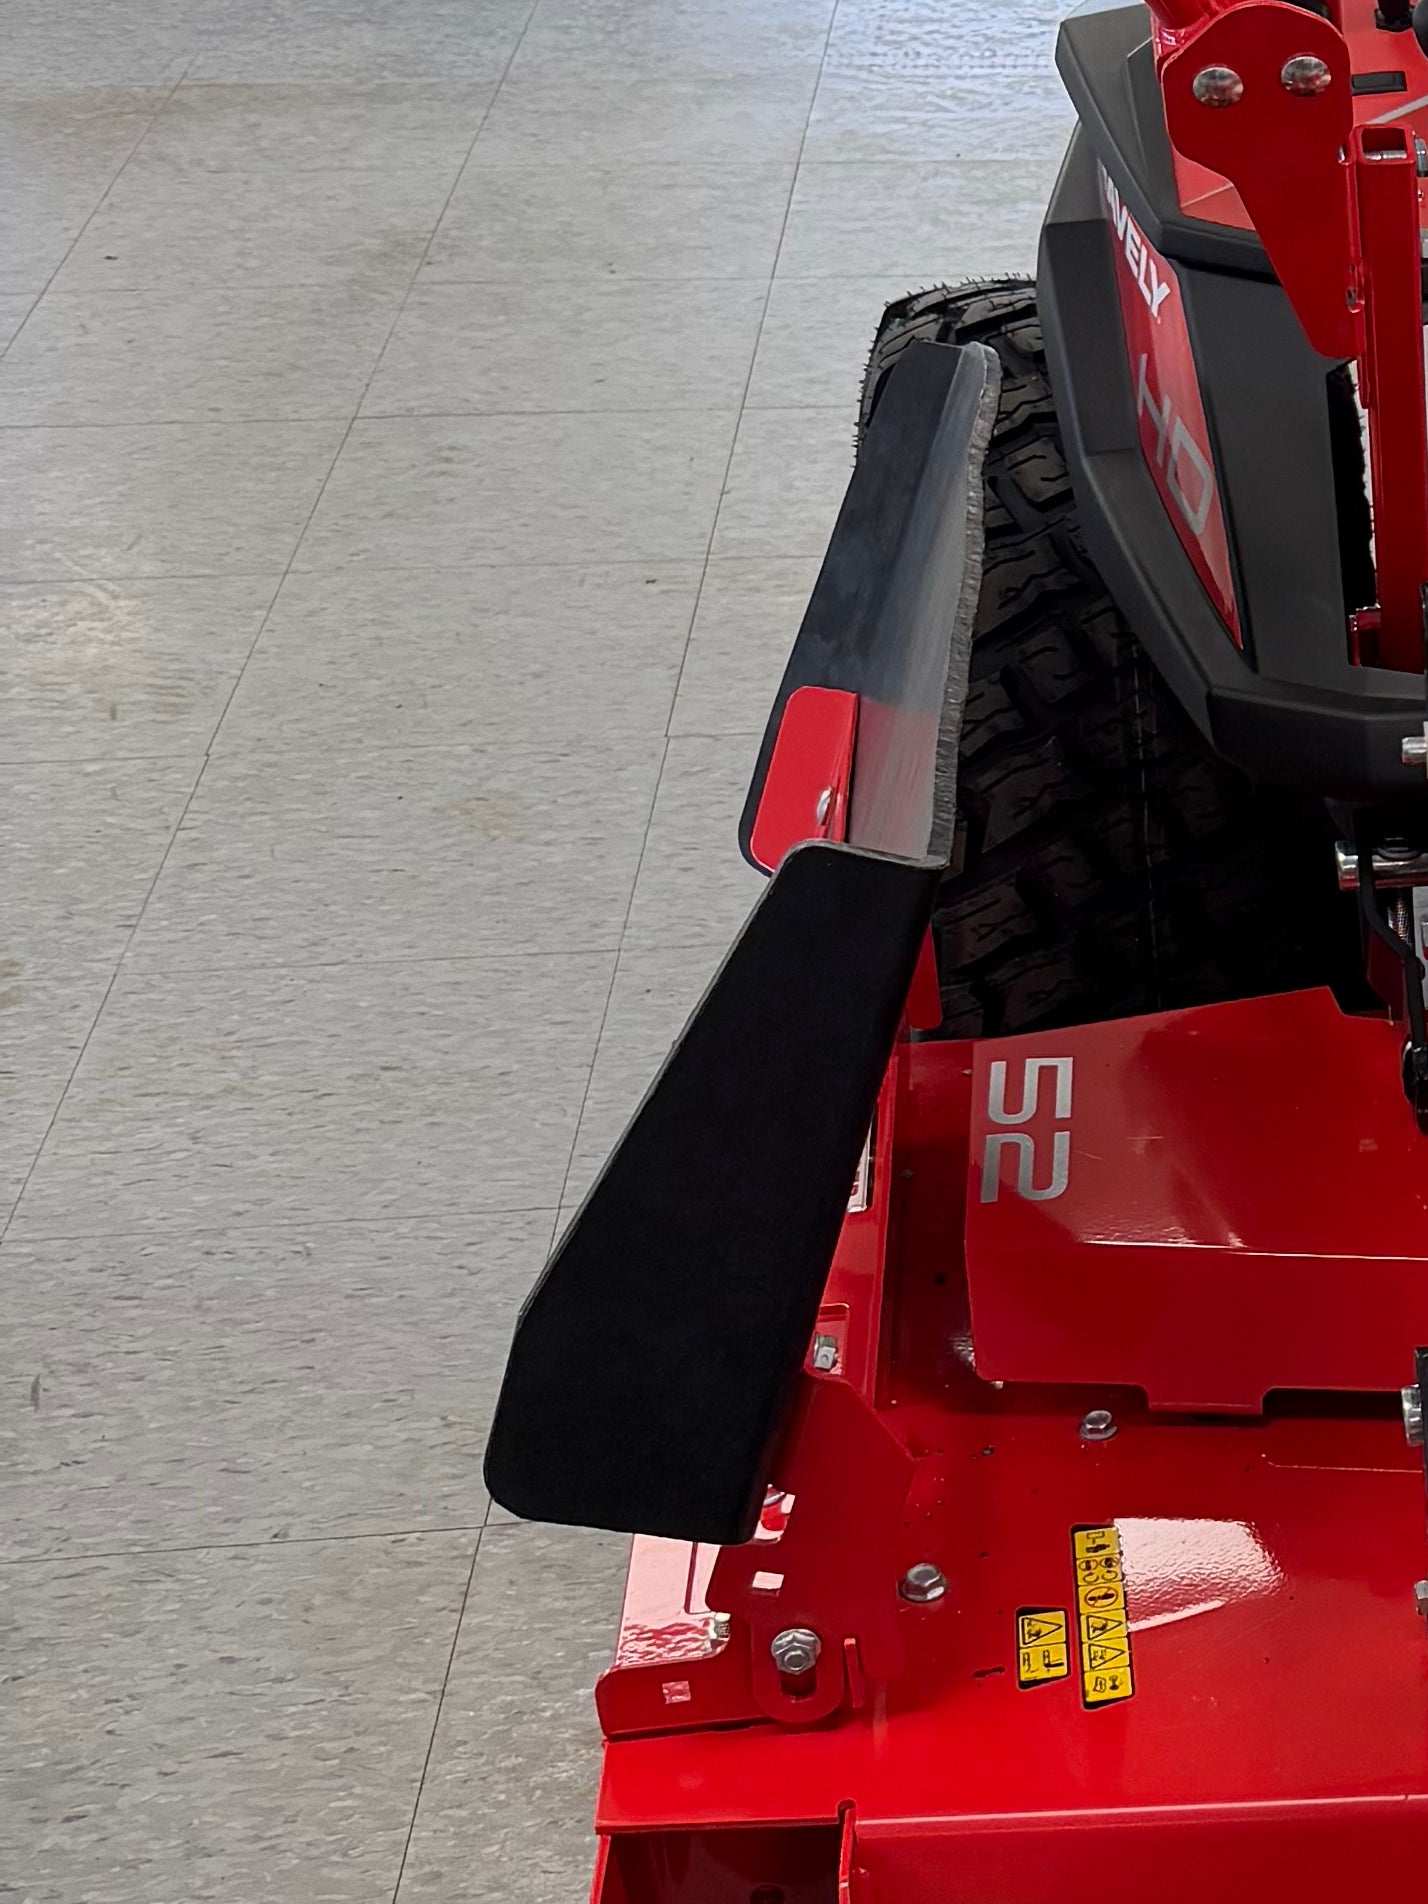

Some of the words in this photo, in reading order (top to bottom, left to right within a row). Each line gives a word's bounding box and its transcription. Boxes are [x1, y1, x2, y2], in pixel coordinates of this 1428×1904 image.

[1099, 160, 1171, 318] AVELY
[1136, 352, 1214, 536] HD
[980, 1056, 1073, 1204] 52
